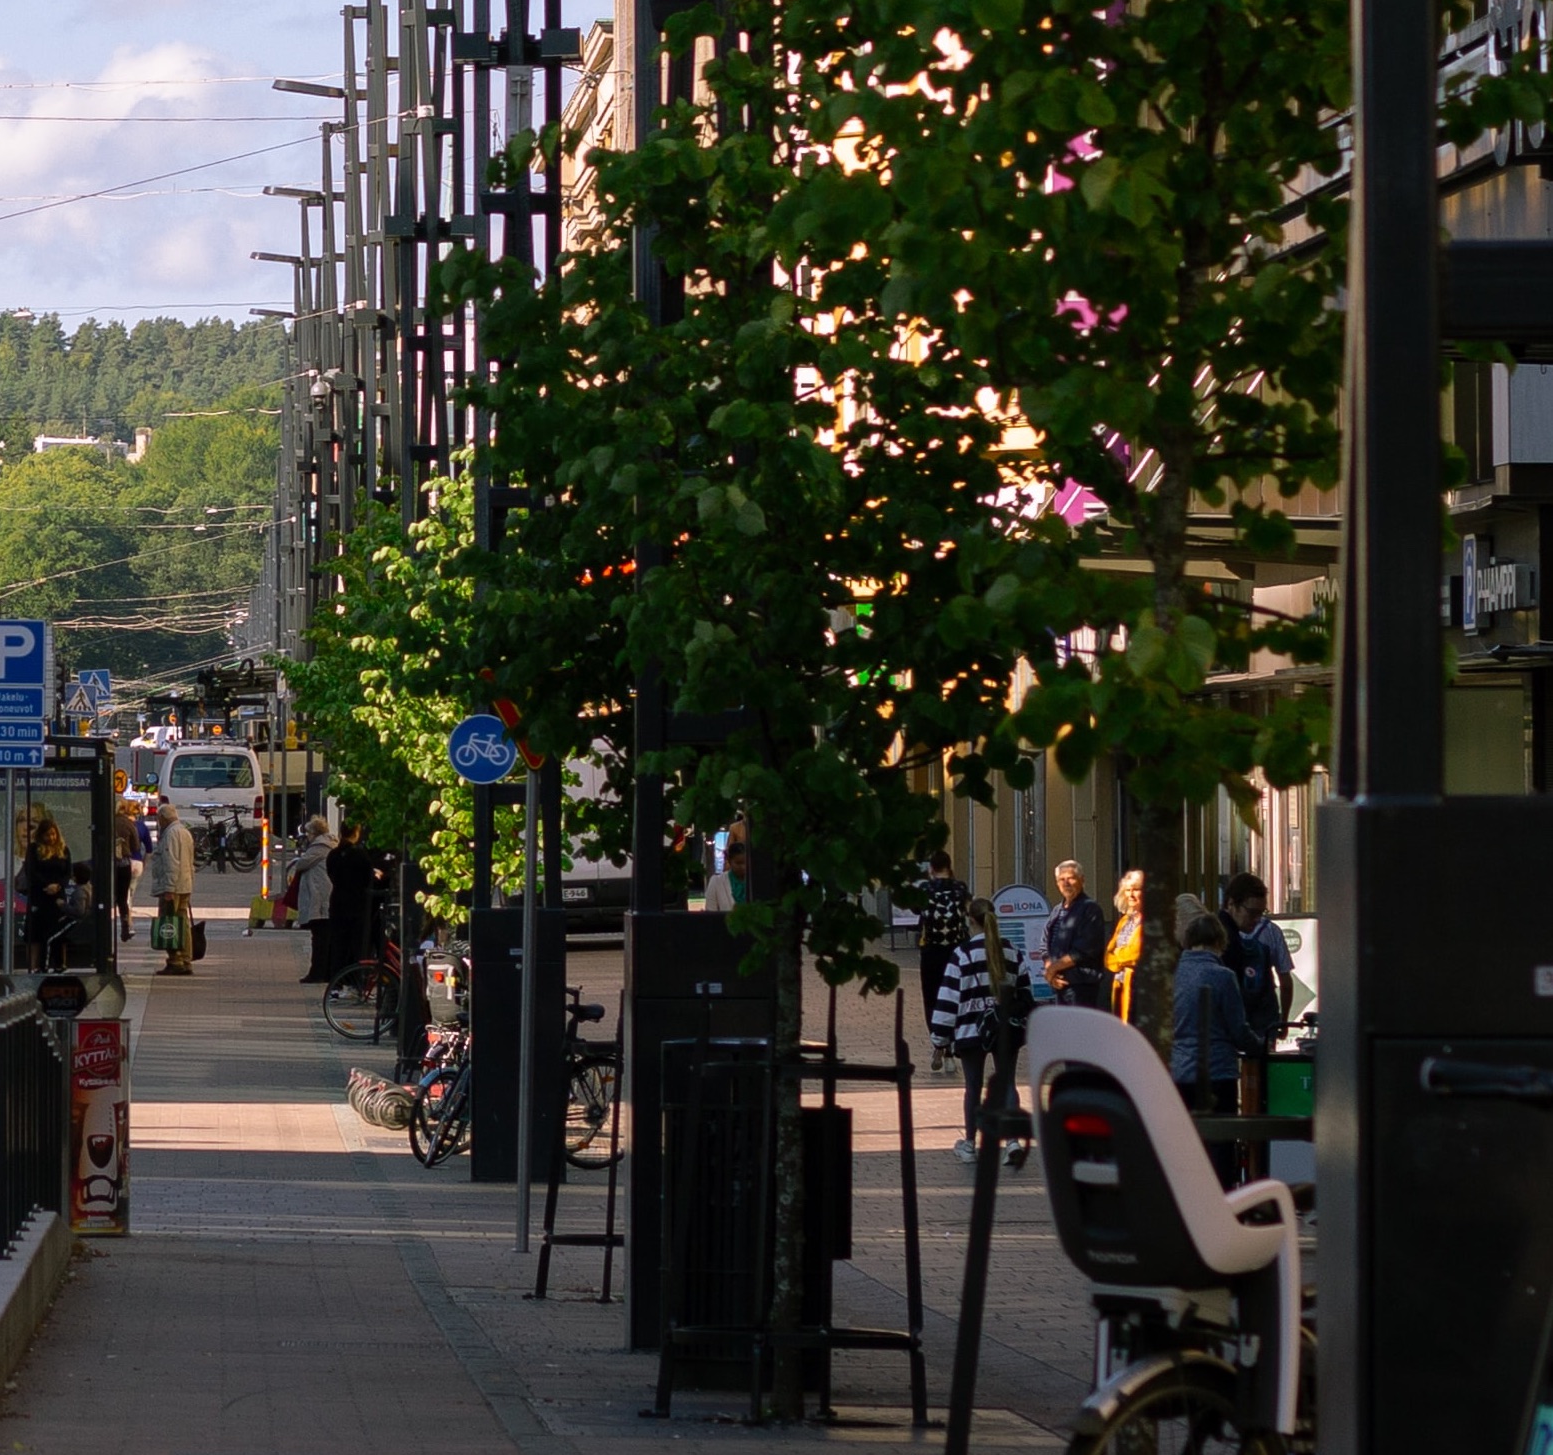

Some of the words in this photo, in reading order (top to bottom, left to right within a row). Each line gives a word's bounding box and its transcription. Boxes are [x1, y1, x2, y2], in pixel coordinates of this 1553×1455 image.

[0, 726, 15, 738] 30
[17, 726, 38, 738] min
[13, 751, 24, 761] m
[1013, 901, 1043, 911] ILONA
[74, 1047, 120, 1069] KYTTÄL
